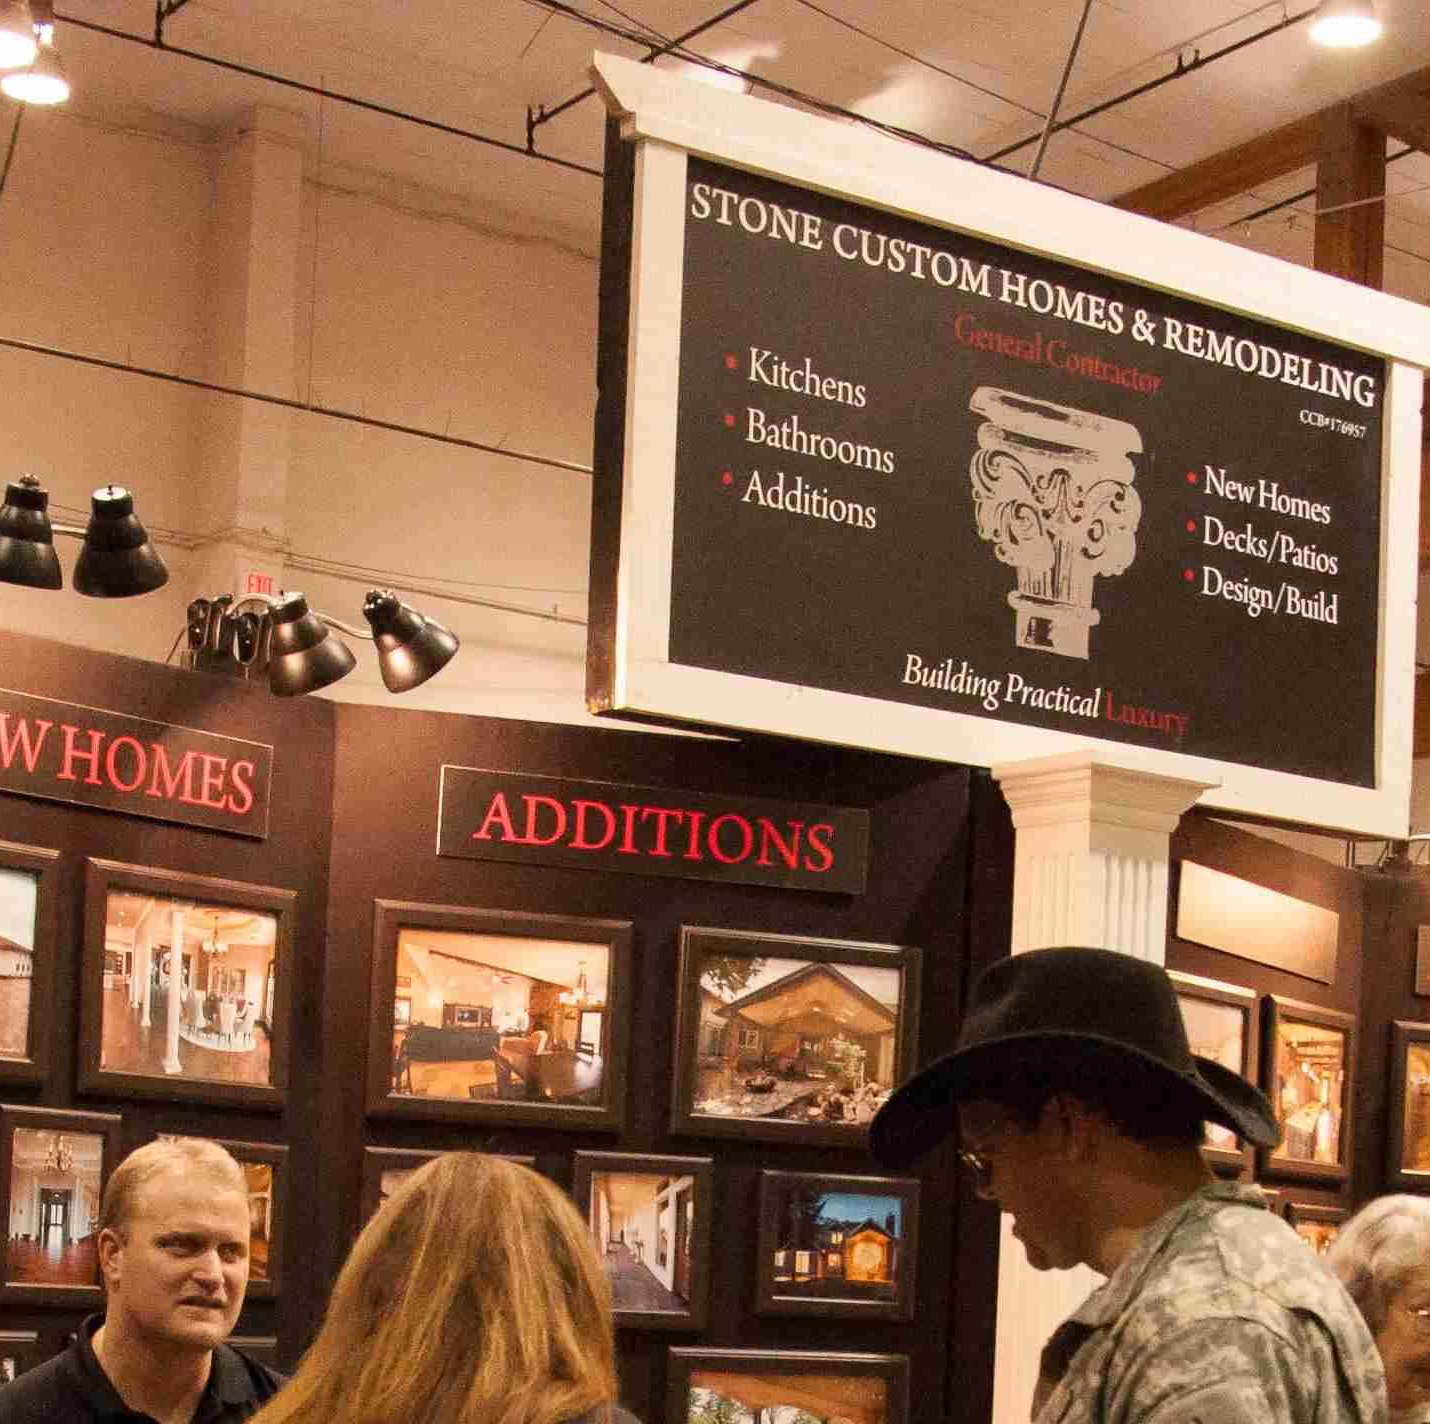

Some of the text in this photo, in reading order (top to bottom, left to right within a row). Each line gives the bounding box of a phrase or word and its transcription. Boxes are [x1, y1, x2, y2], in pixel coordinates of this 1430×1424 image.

[691, 182, 1376, 407] STONE CUSTOM HOMES & REMODELING
[747, 347, 866, 409] Kitchens
[954, 314, 1163, 394] General Contractor
[745, 409, 895, 474] Bathrooms
[742, 470, 877, 530] Additions
[1205, 465, 1331, 525] New Homes
[1203, 518, 1339, 576] Decks/Patios
[1202, 567, 1339, 626] Design/Build
[902, 654, 1191, 738] Building Practical Luxury
[58, 724, 255, 815] HOMES
[472, 790, 836, 875] ADDITIONS
